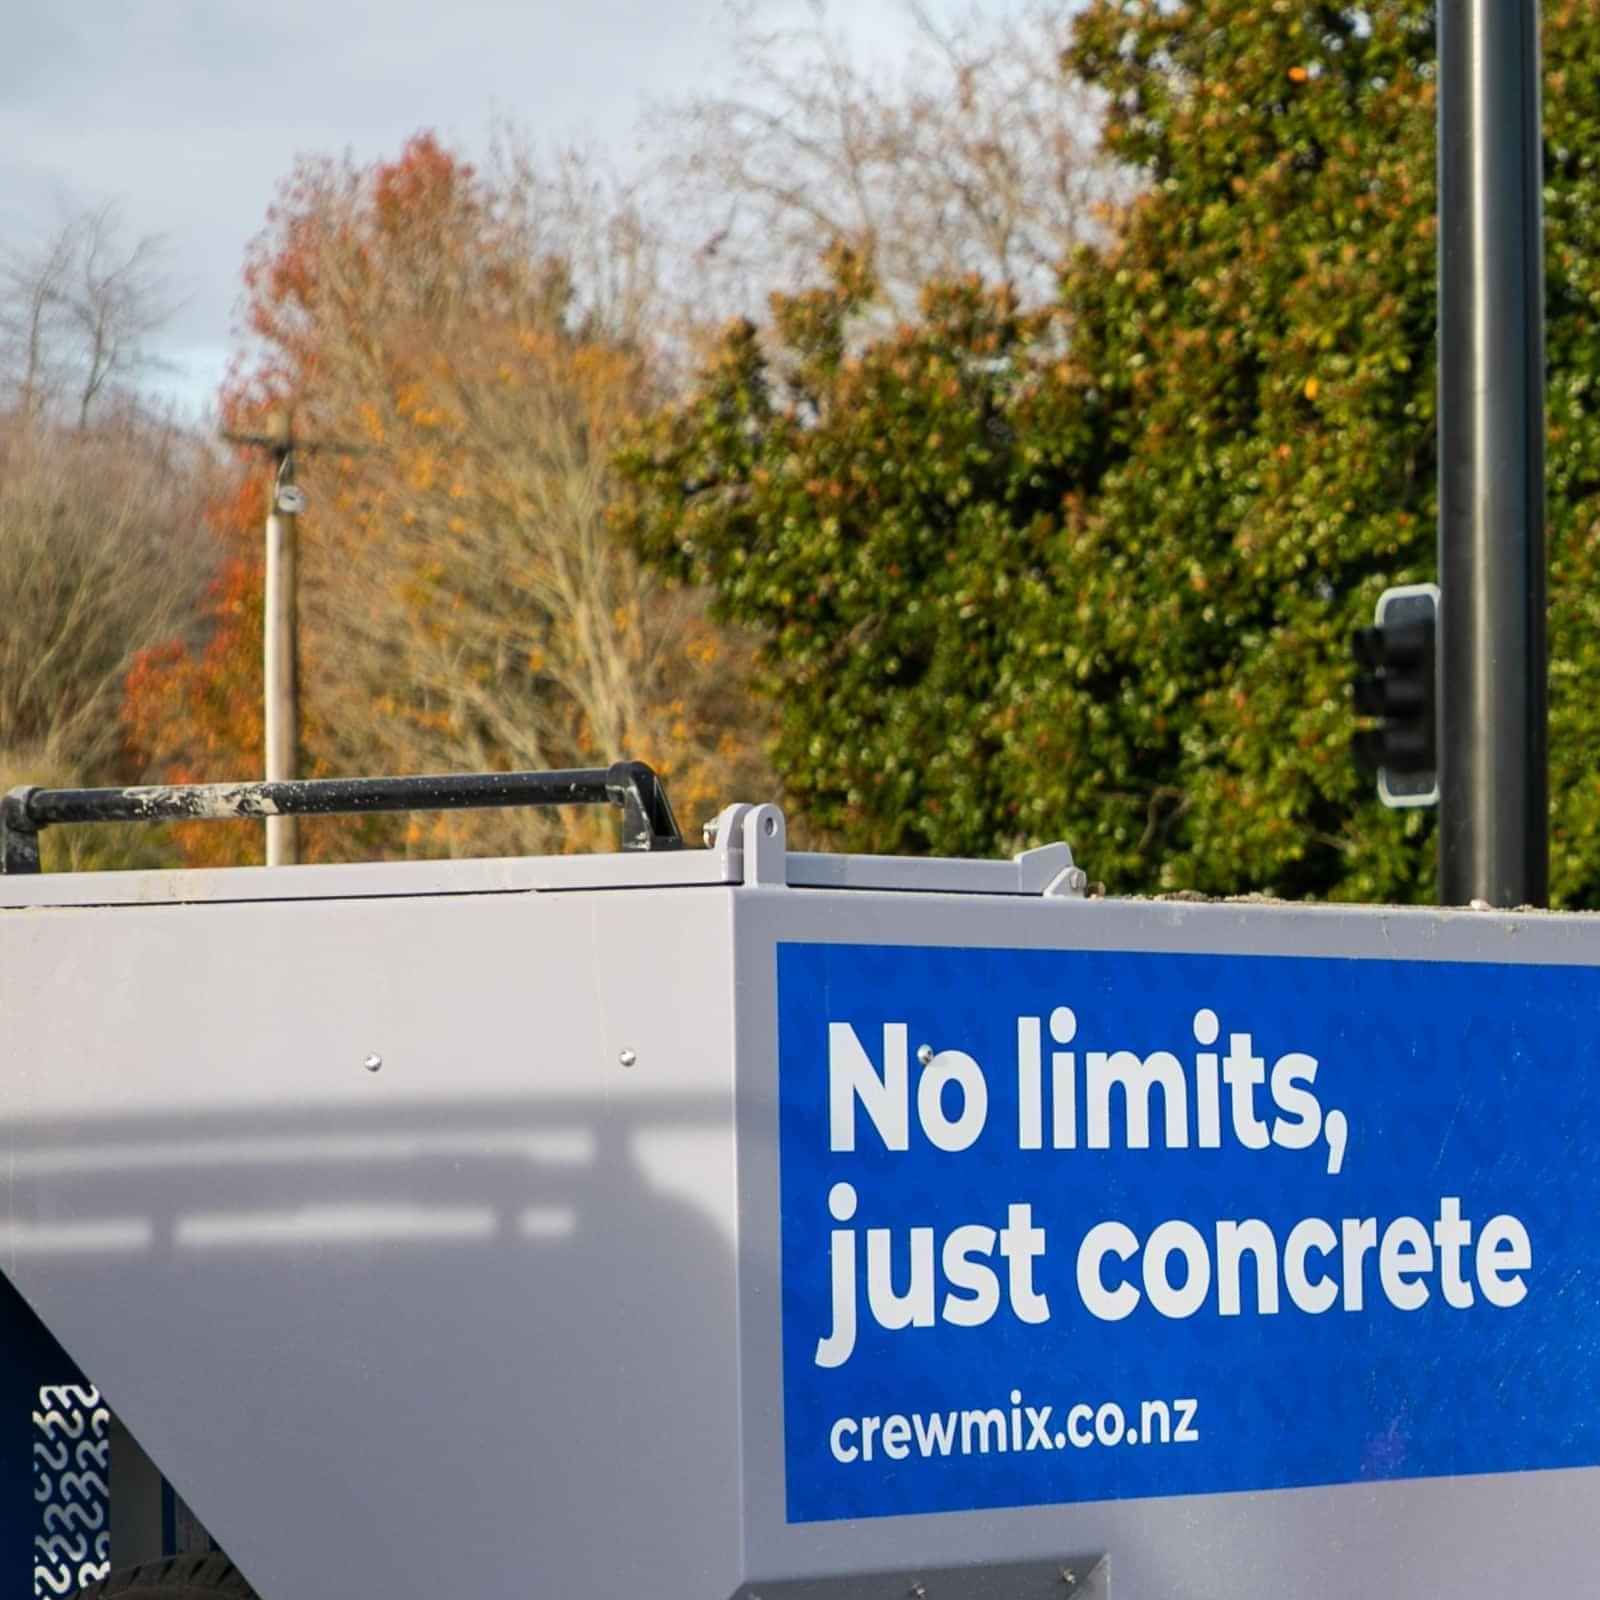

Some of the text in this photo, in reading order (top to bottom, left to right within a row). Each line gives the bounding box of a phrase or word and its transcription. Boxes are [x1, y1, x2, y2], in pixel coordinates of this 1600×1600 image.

[829, 1006, 1348, 1174] No limits,
[815, 1182, 1532, 1368] just concrete
[830, 1389, 1199, 1463] crewmix.co.nz
